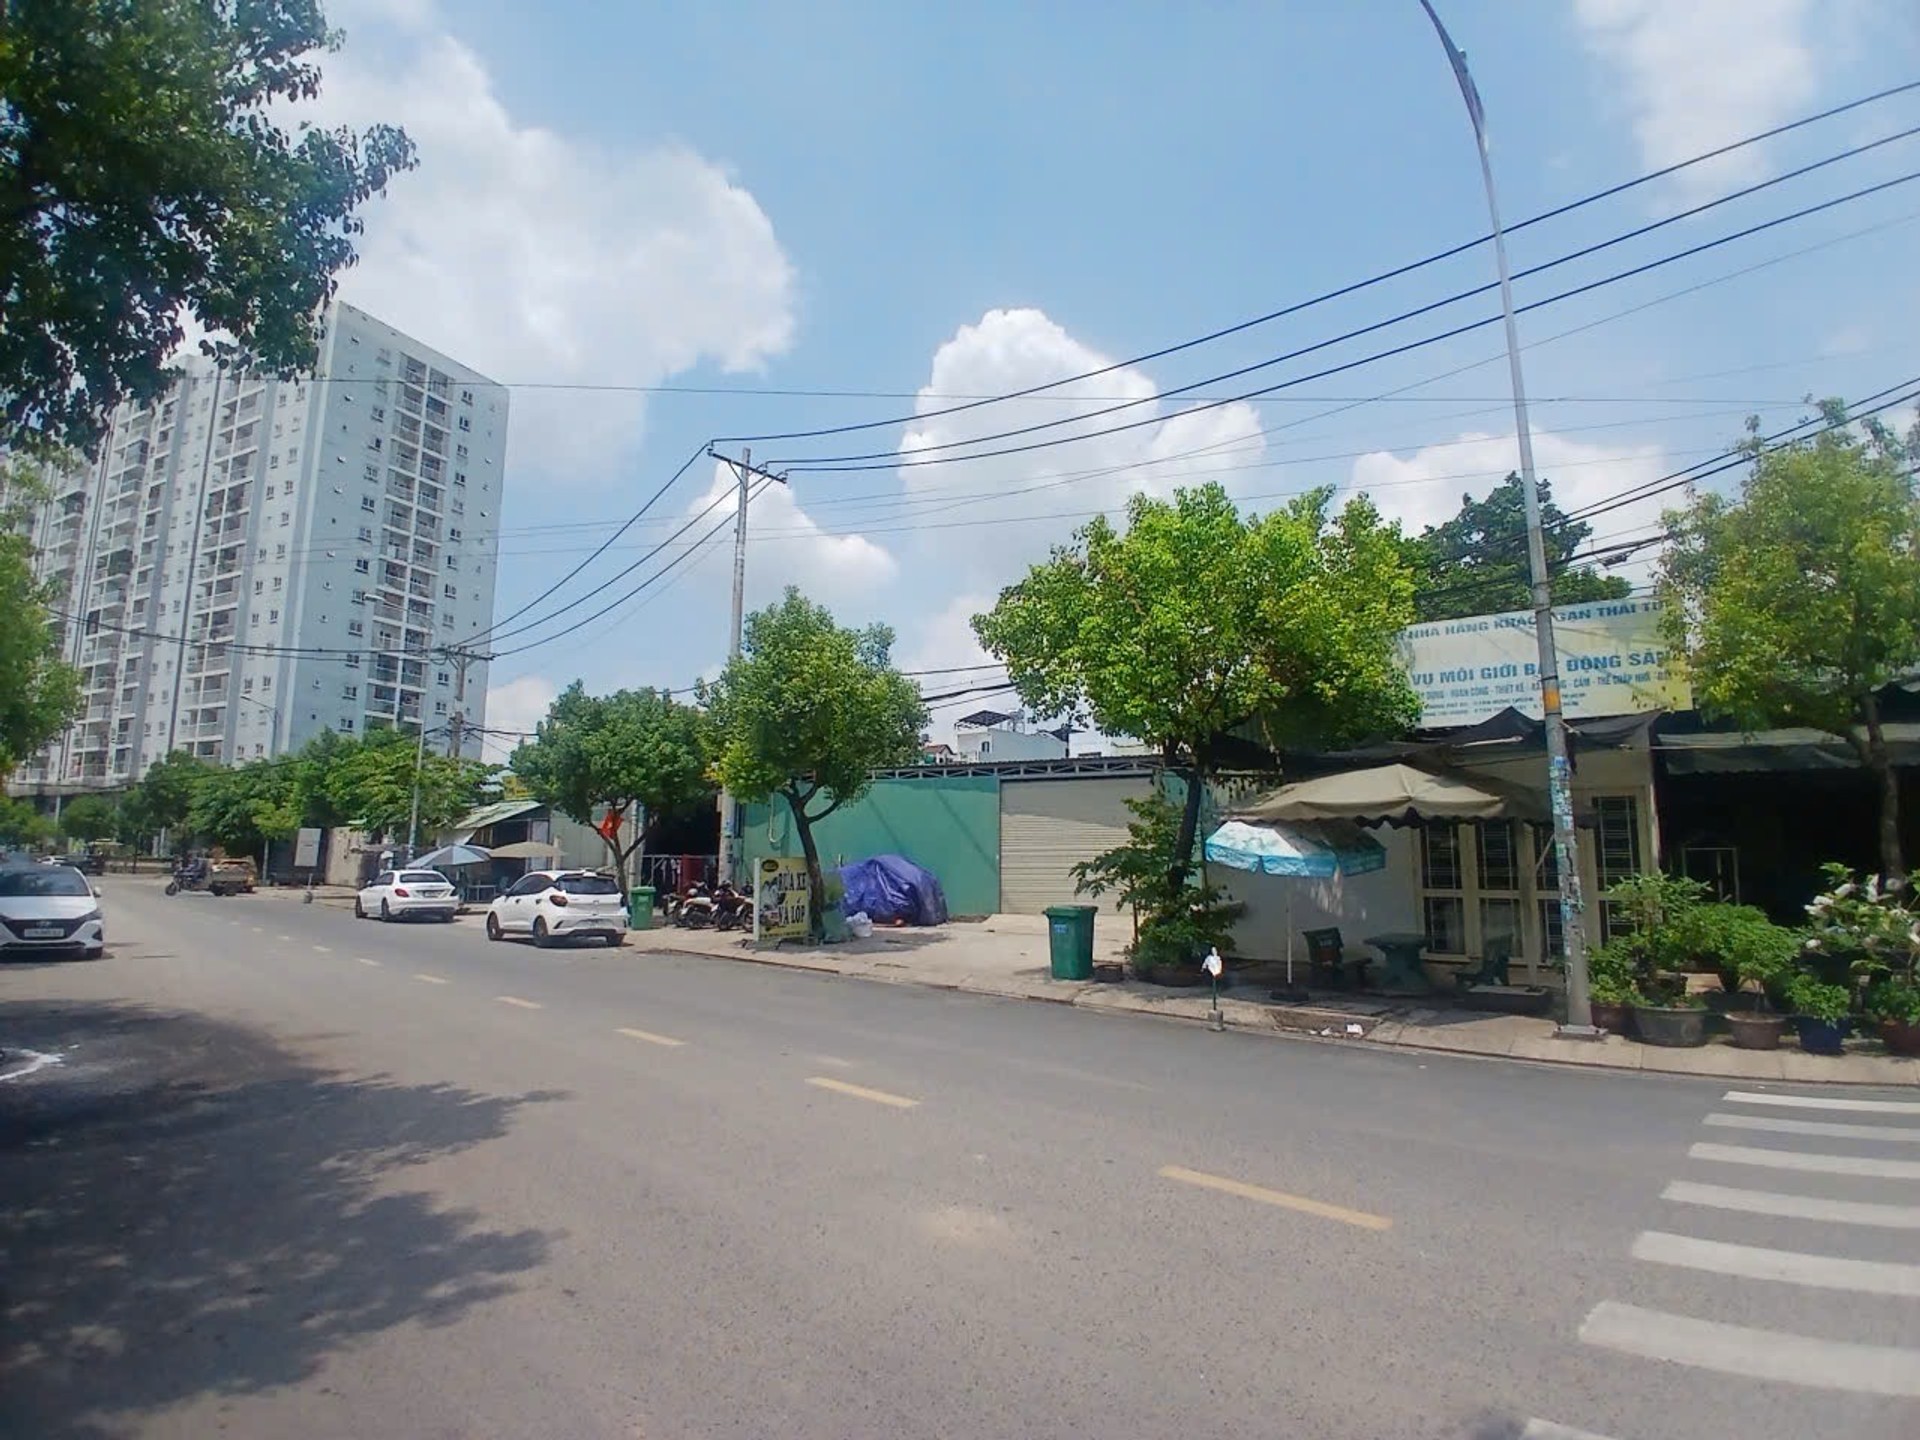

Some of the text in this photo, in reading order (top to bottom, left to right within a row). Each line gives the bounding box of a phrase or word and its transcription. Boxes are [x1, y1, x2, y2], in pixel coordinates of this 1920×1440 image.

[1440, 667, 1474, 684] MÔI
[1480, 663, 1518, 680] GIỚI
[1566, 655, 1622, 672] ĐỘNG
